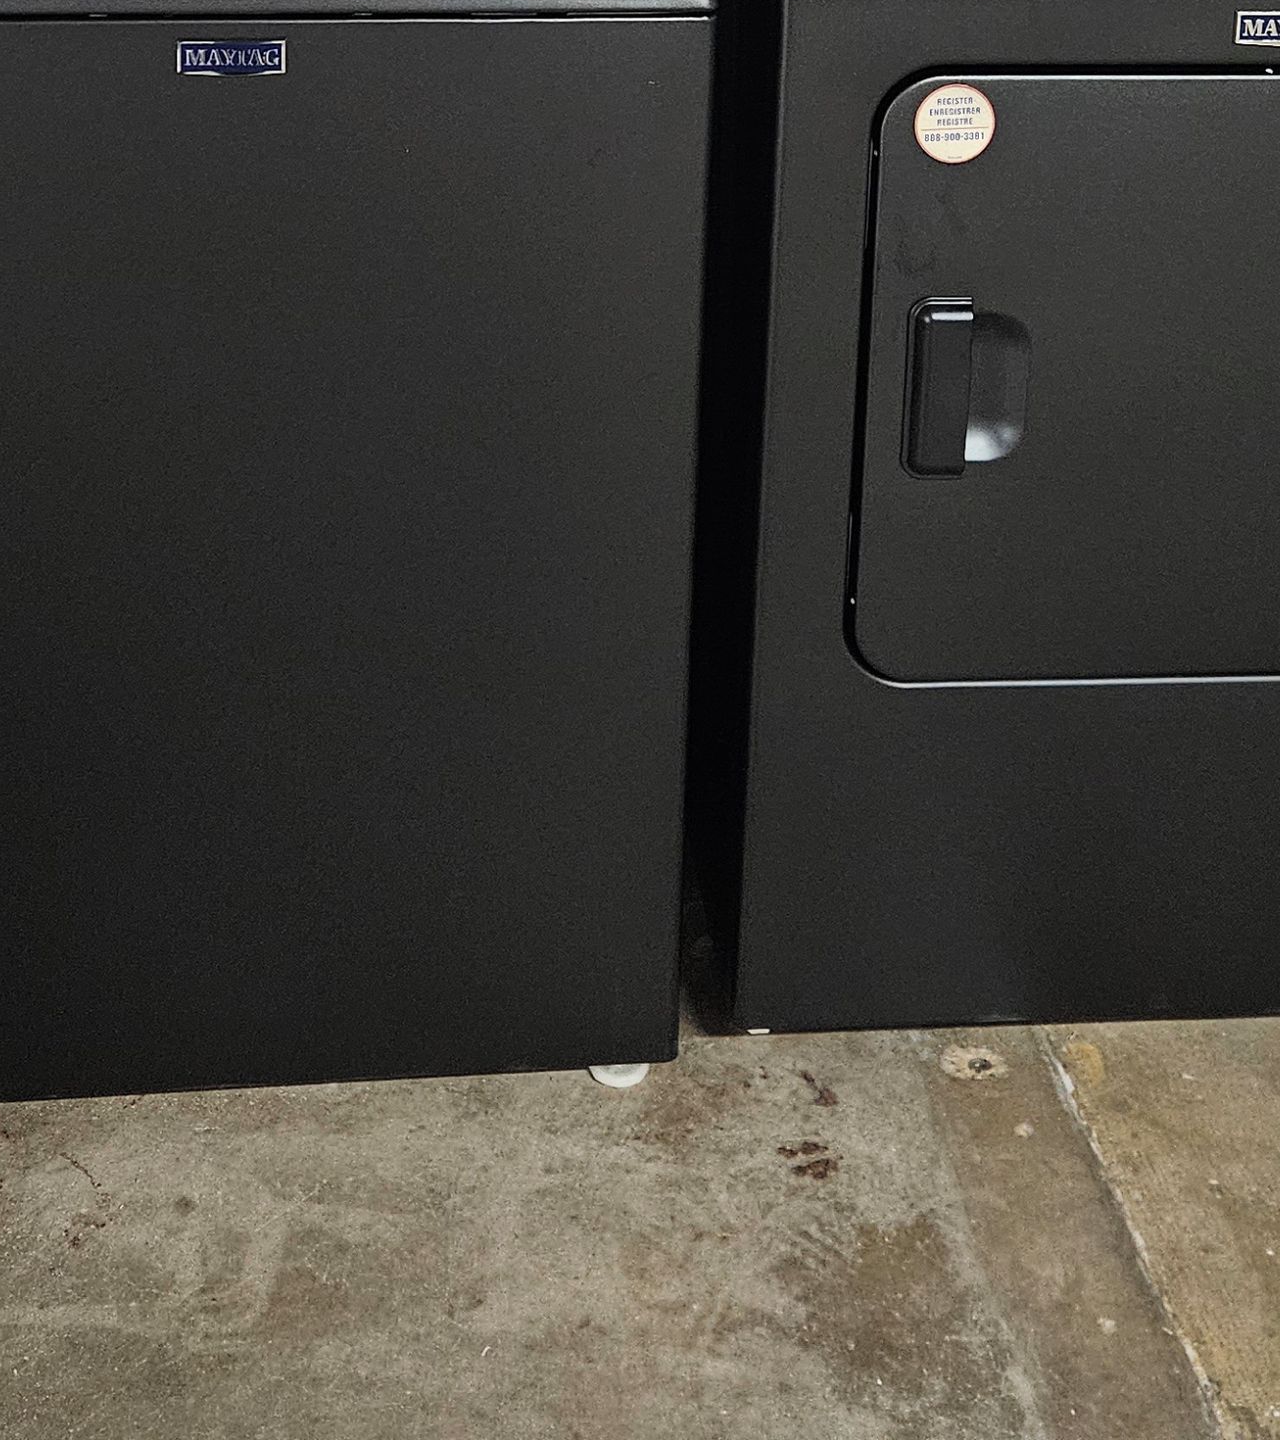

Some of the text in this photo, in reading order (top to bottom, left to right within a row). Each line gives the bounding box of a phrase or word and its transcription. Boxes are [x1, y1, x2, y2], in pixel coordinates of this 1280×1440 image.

[184, 48, 280, 66] MAYTAG
[936, 96, 974, 106] REGISTER
[929, 106, 981, 117] ENREGISTRER
[936, 117, 974, 127] REGISTRE
